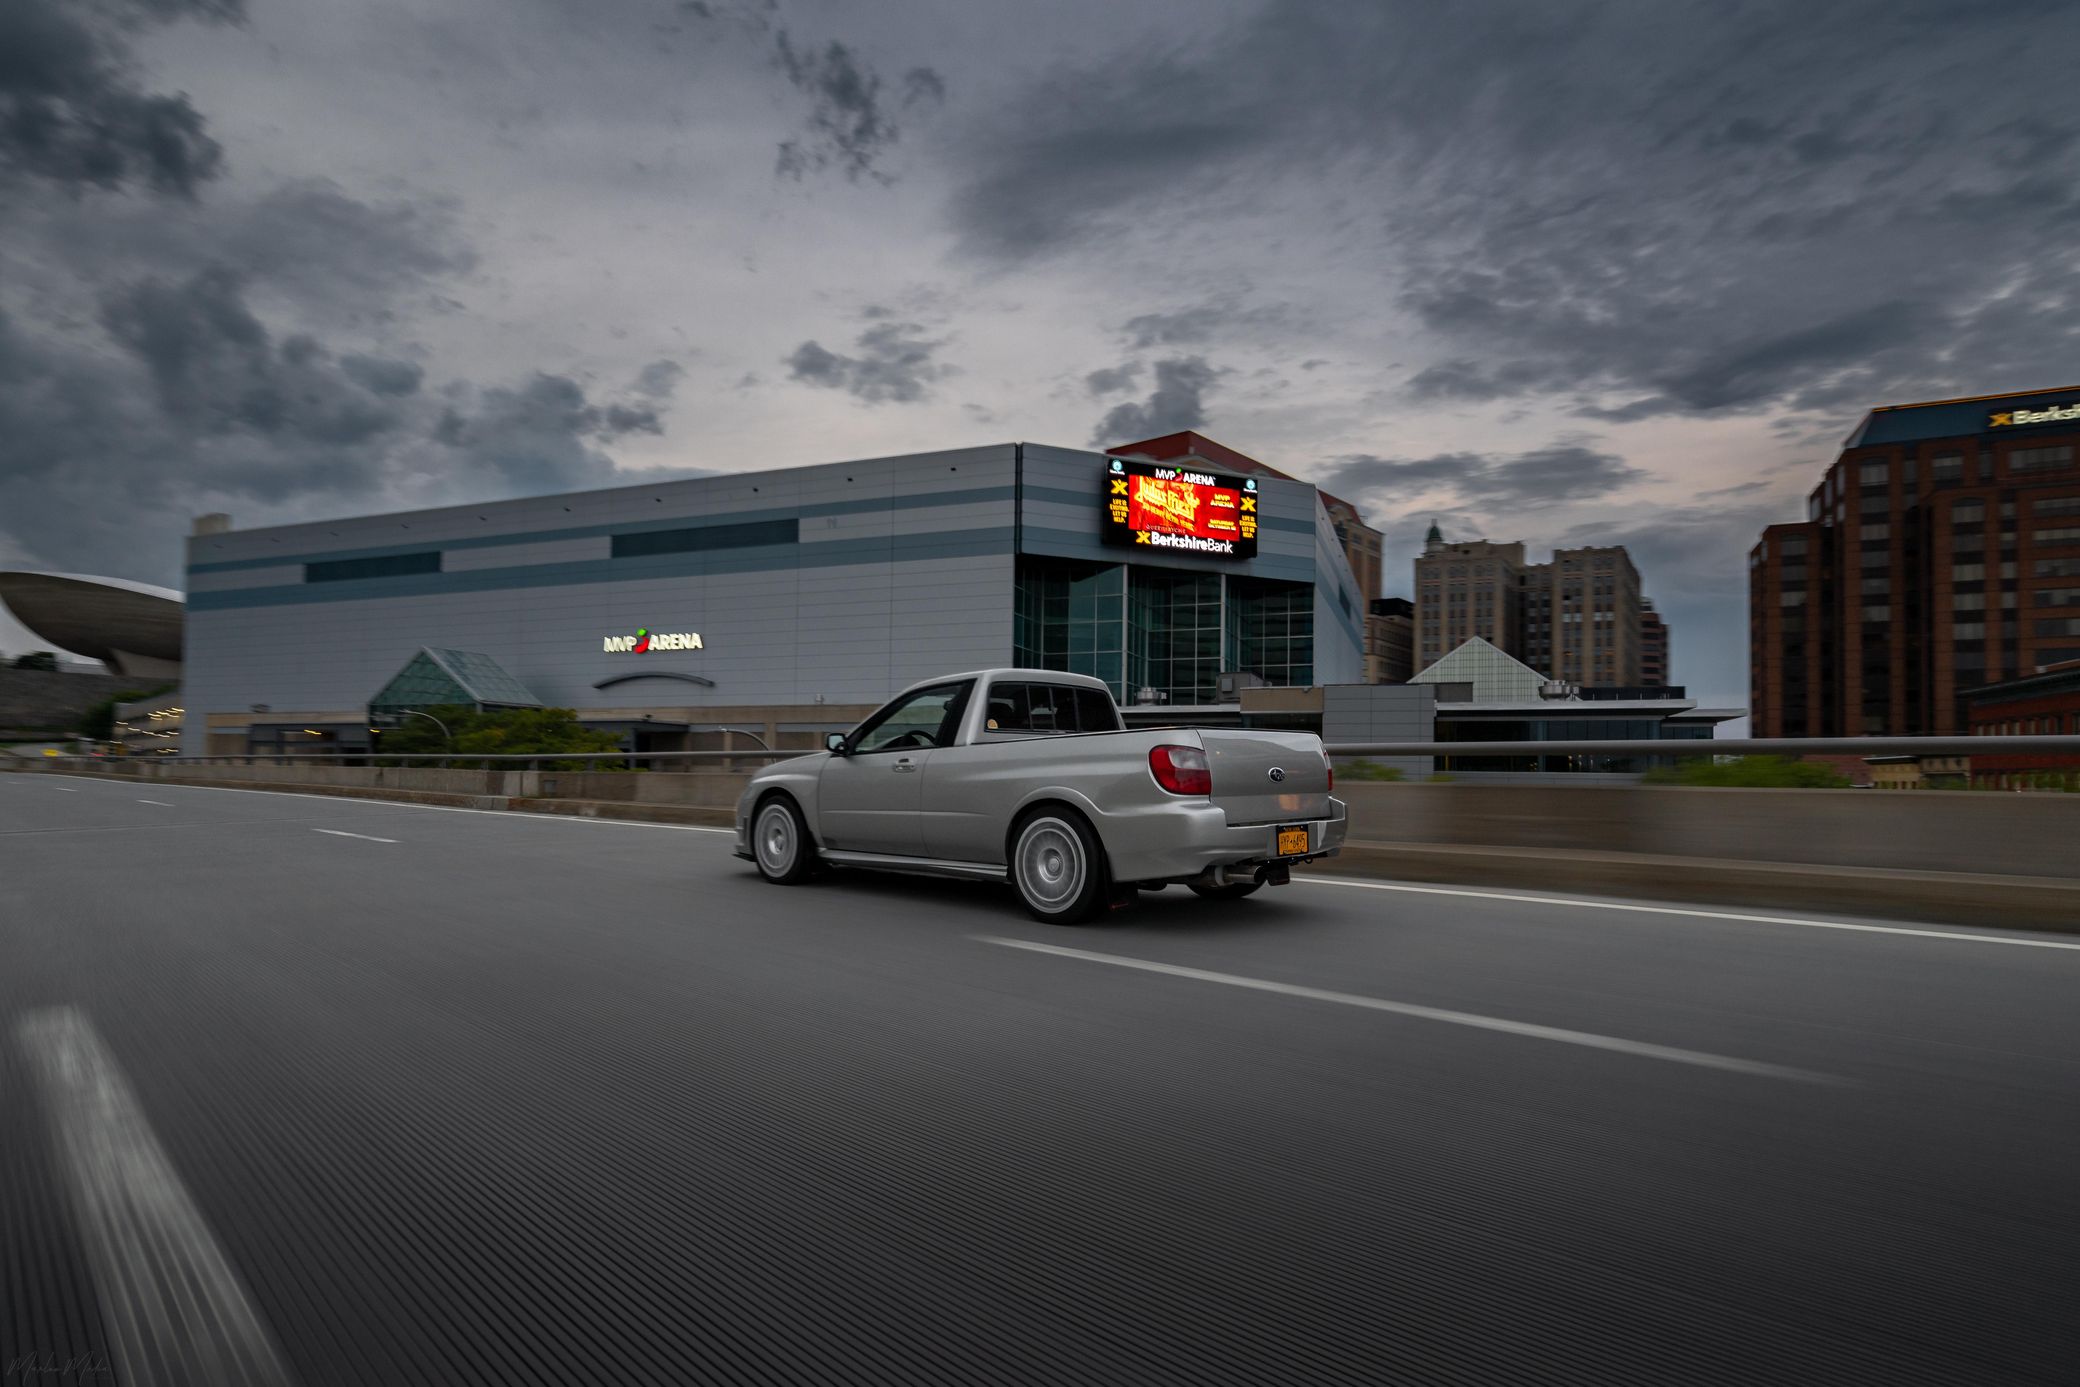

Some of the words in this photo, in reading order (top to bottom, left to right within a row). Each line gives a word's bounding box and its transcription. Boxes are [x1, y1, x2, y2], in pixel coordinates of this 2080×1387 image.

[1155, 468, 1176, 480] MVP
[1183, 472, 1215, 486] ARENA
[1210, 500, 1234, 508] ARENA
[1151, 531, 1233, 554] BerkshireBank
[603, 636, 637, 652] MVP
[648, 633, 703, 651] ARENA
